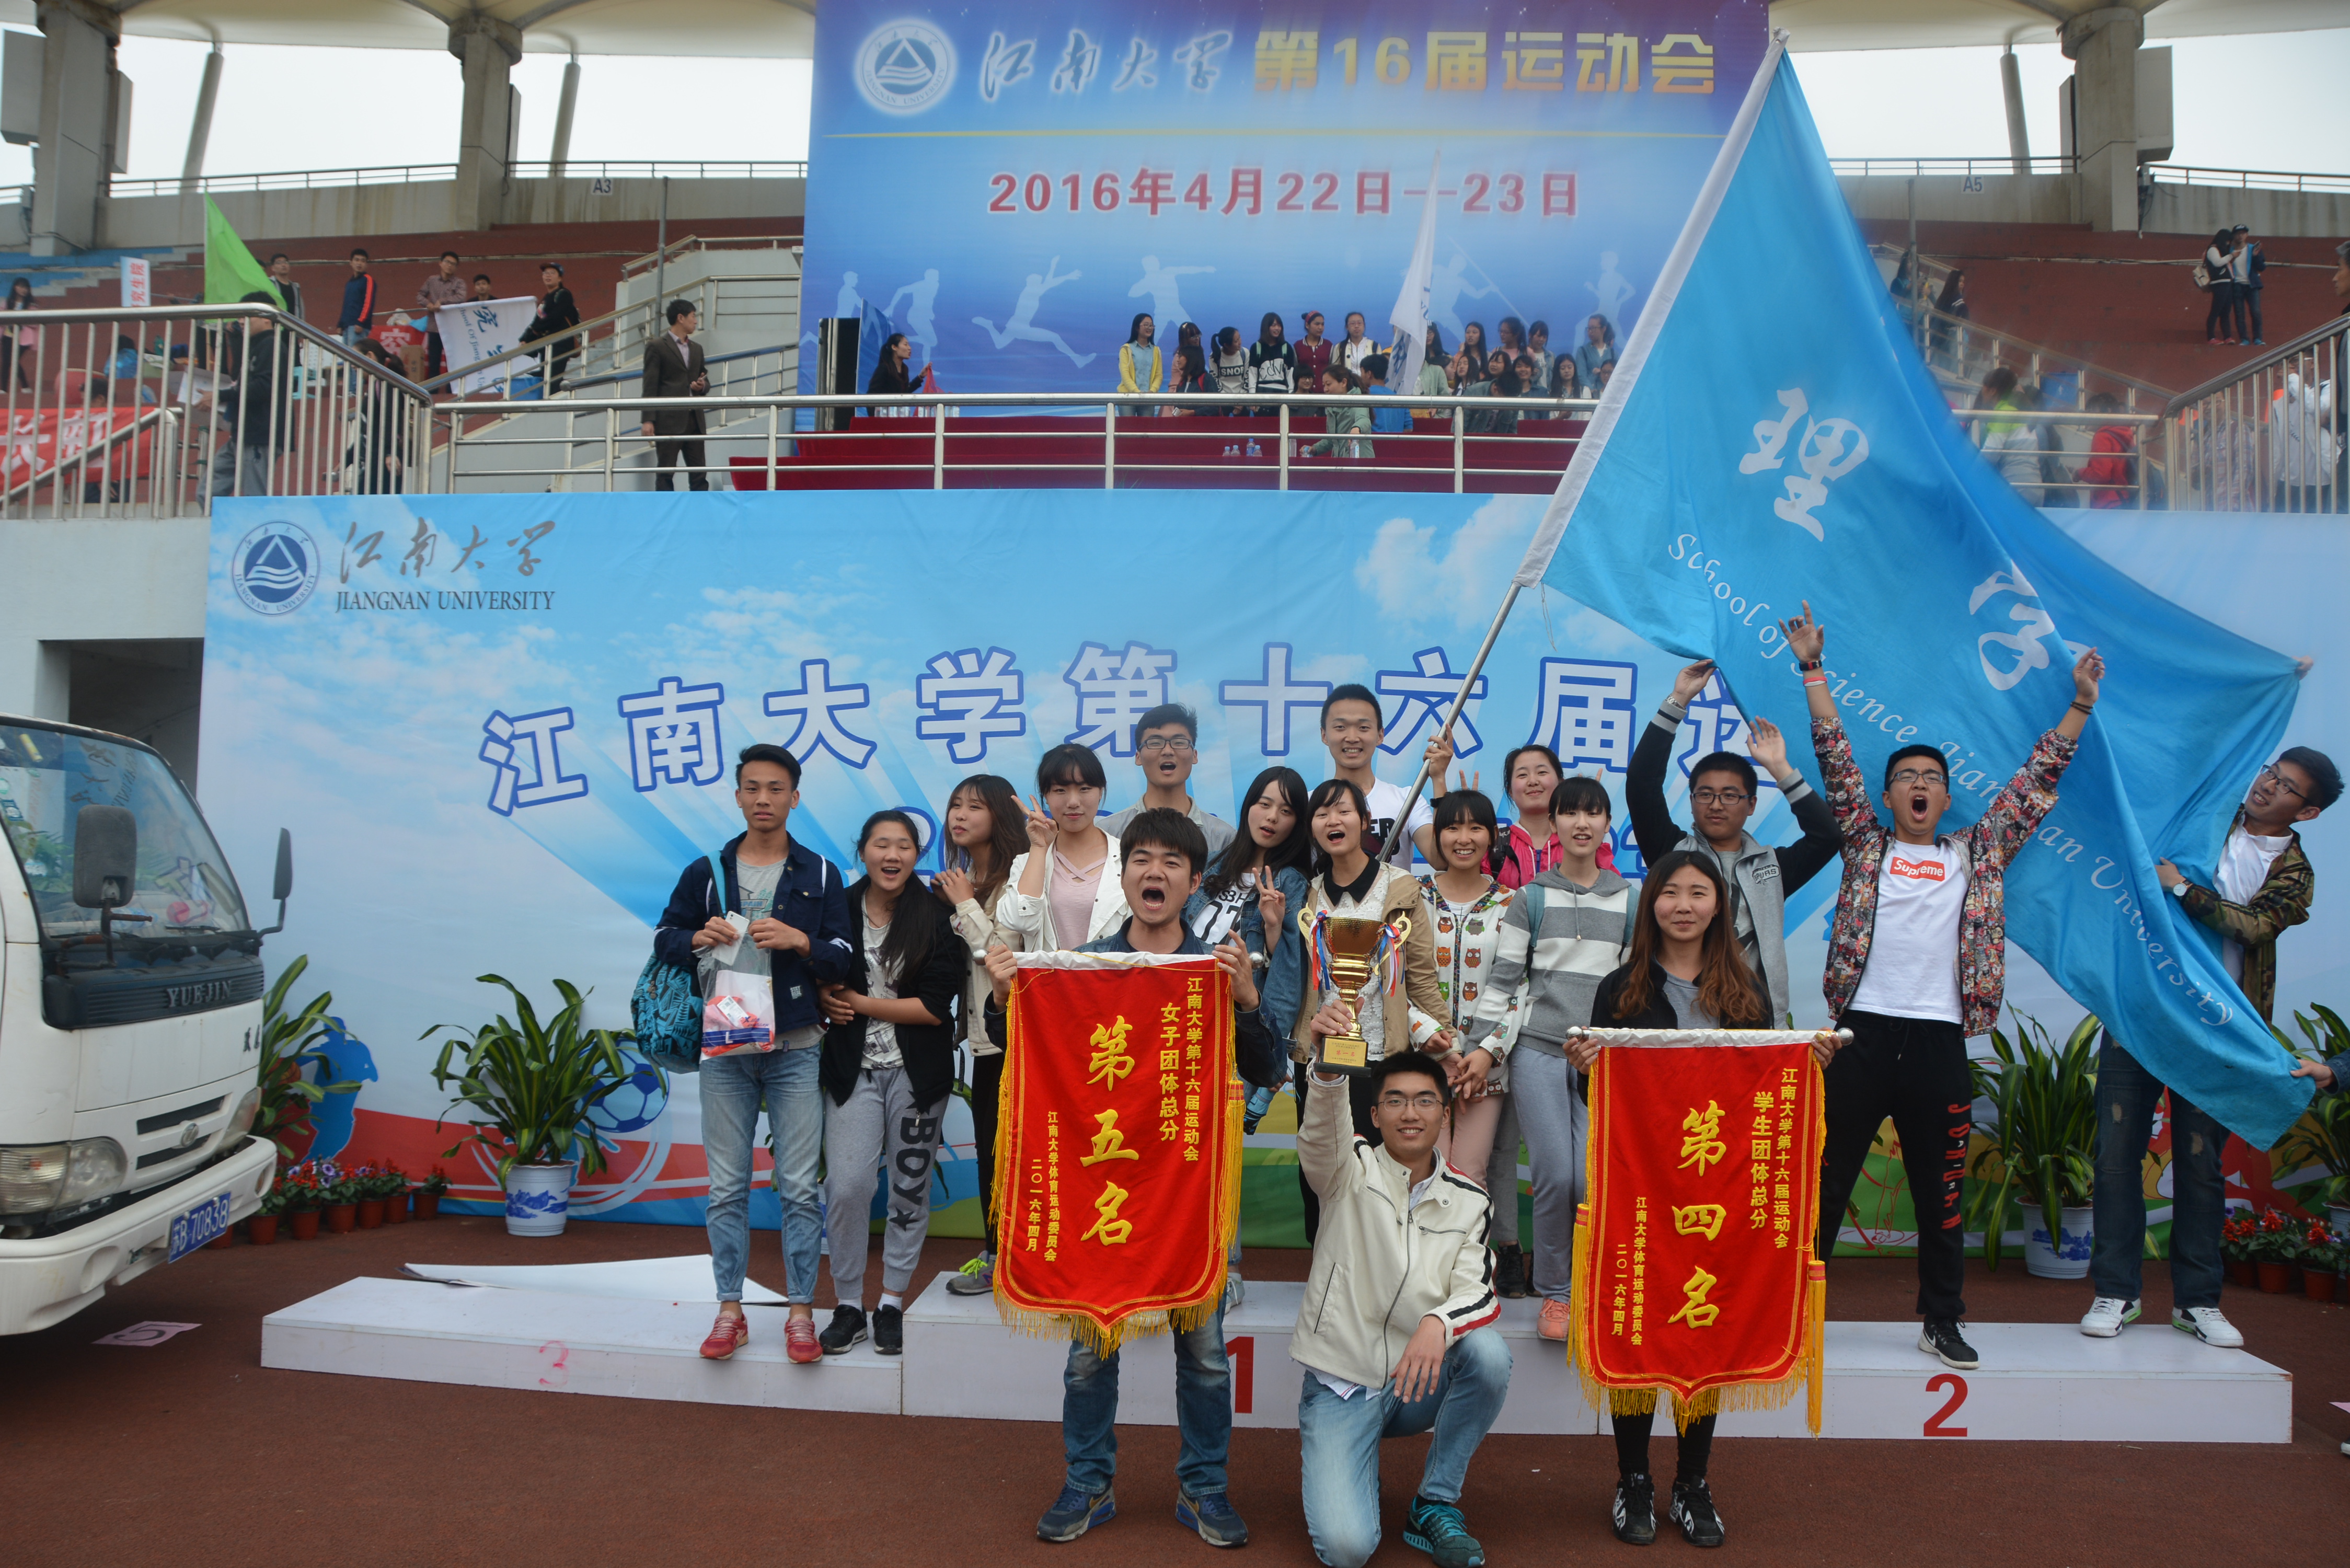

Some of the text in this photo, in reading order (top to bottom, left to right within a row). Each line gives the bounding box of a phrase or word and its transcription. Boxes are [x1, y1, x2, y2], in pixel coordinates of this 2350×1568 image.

[984, 31, 1714, 98] 江南大学 第16届运动会
[592, 178, 611, 193] A3
[1963, 176, 1983, 192] A5
[129, 262, 145, 307] 究生院
[339, 516, 556, 584] 江南大学
[235, 573, 315, 612] JIANGNAN UNIVERSITY
[336, 591, 556, 613] JIANGNAN UNIVERSITY
[1668, 534, 1770, 626] School
[1759, 626, 1790, 659] of
[2091, 856, 2232, 1025] University
[1754, 868, 1777, 881] SPURS
[1894, 860, 1943, 877] Supreme
[167, 981, 232, 1008] YUEJIN
[725, 1031, 733, 1044] L
[1183, 977, 1203, 1162] 江南大学第十六届运动会
[1159, 1002, 1181, 1142] 女子团体总分
[892, 1116, 939, 1206] BOY
[1080, 1015, 1139, 1246] 第五名
[1750, 1091, 1774, 1230] 学生团体总分
[1773, 1068, 1798, 1249] 江南大学第十六届运动会
[1044, 1111, 1060, 1262] 江南大学体育运动委员会
[1667, 1100, 1726, 1329] 第四名
[1631, 1196, 1647, 1346] 江南大学体育运动委员会
[539, 1341, 569, 1387] 3
[1227, 1336, 1254, 1414] 1
[1923, 1374, 1968, 1436] 2
